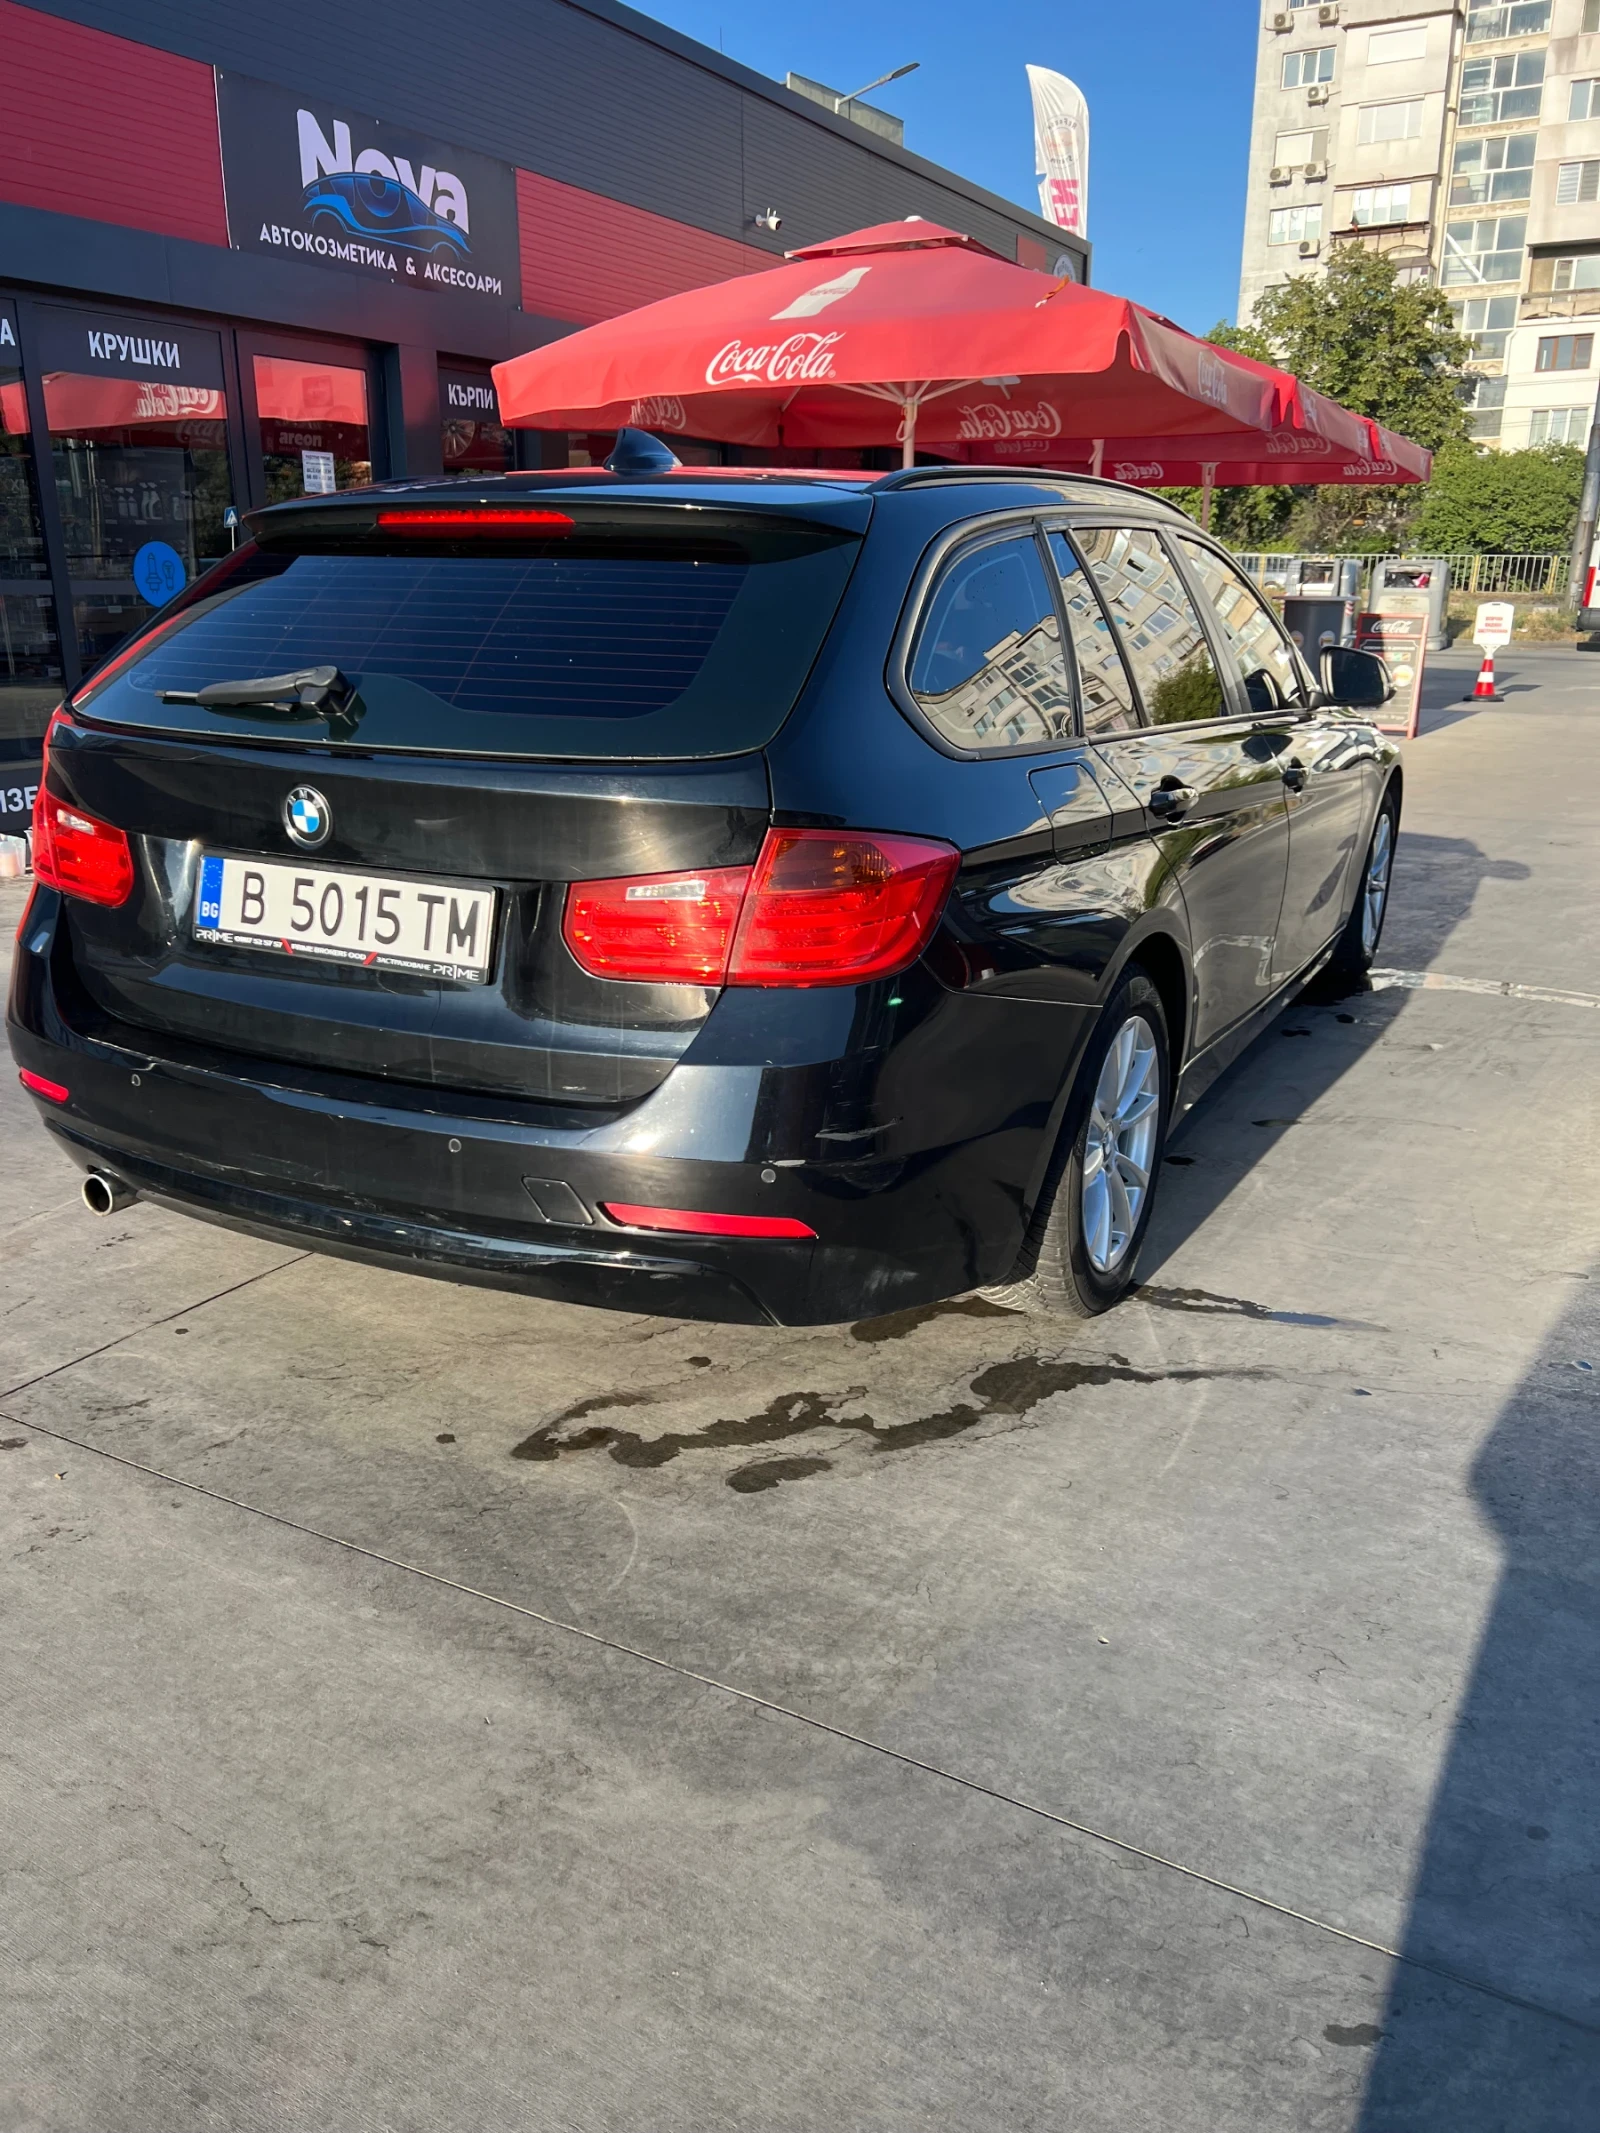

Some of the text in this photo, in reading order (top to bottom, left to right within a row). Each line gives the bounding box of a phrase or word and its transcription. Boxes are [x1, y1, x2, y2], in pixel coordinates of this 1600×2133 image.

[297, 109, 470, 234] Nova
[260, 223, 502, 296] АВТОКОЗМЕТИКА & АКСЕСОАРИ
[88, 330, 181, 369] КРУШКИ
[705, 331, 847, 386] Coca-Cola
[447, 383, 494, 410] КЪРПИ
[279, 431, 323, 447] areon
[201, 901, 219, 918] BG
[240, 871, 480, 957] B 5015 TM
